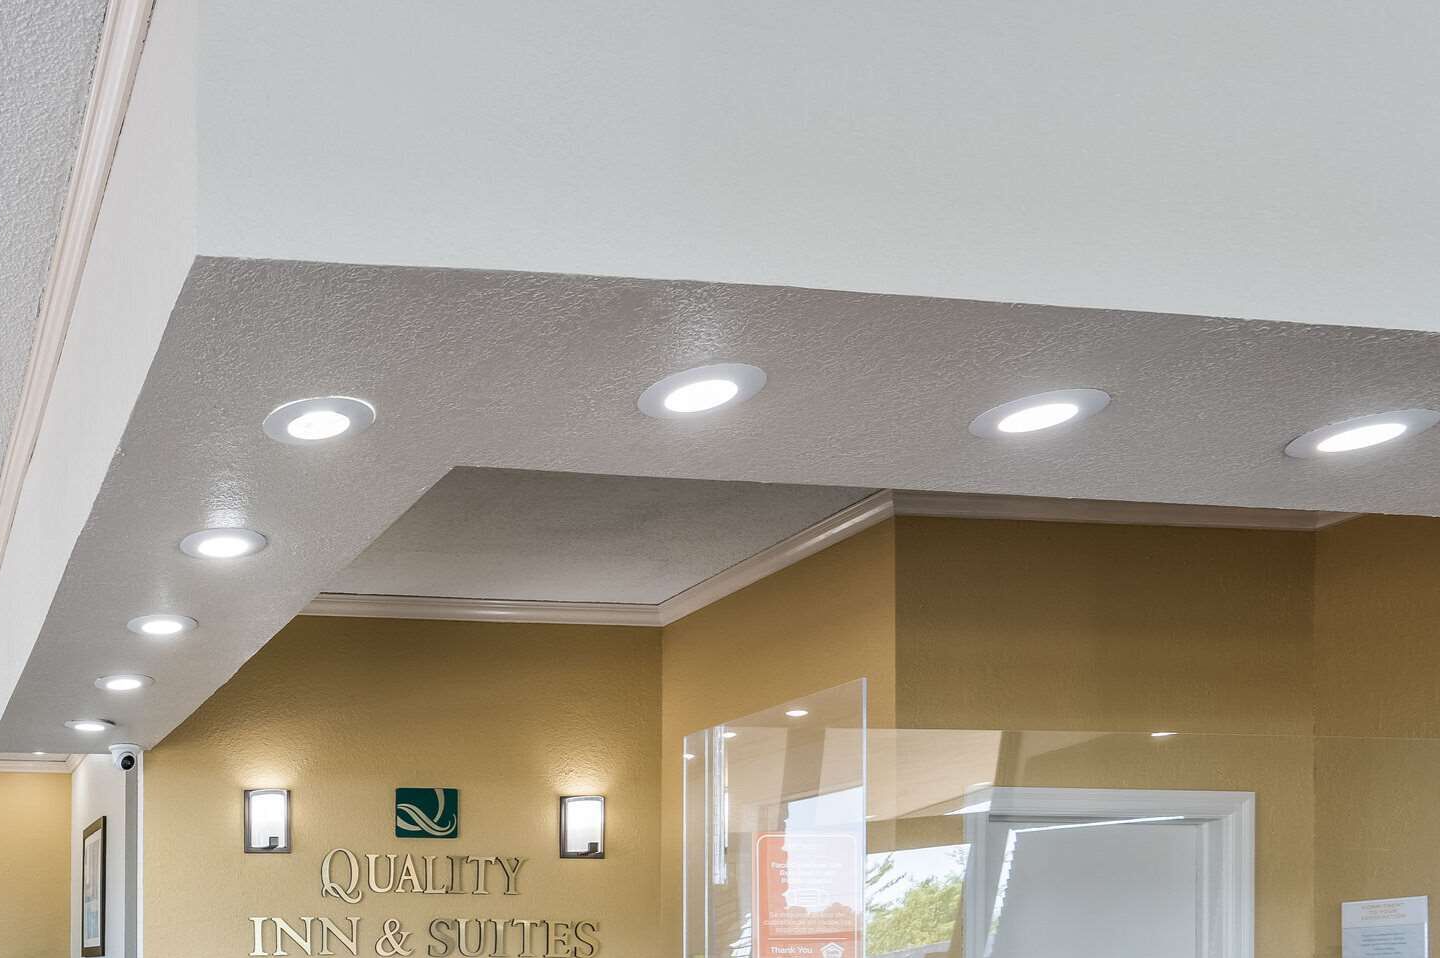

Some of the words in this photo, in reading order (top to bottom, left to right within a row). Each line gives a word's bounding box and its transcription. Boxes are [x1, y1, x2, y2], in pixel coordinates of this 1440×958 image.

[320, 848, 528, 904] QUALITY
[248, 916, 361, 957] INN
[374, 918, 416, 957] &
